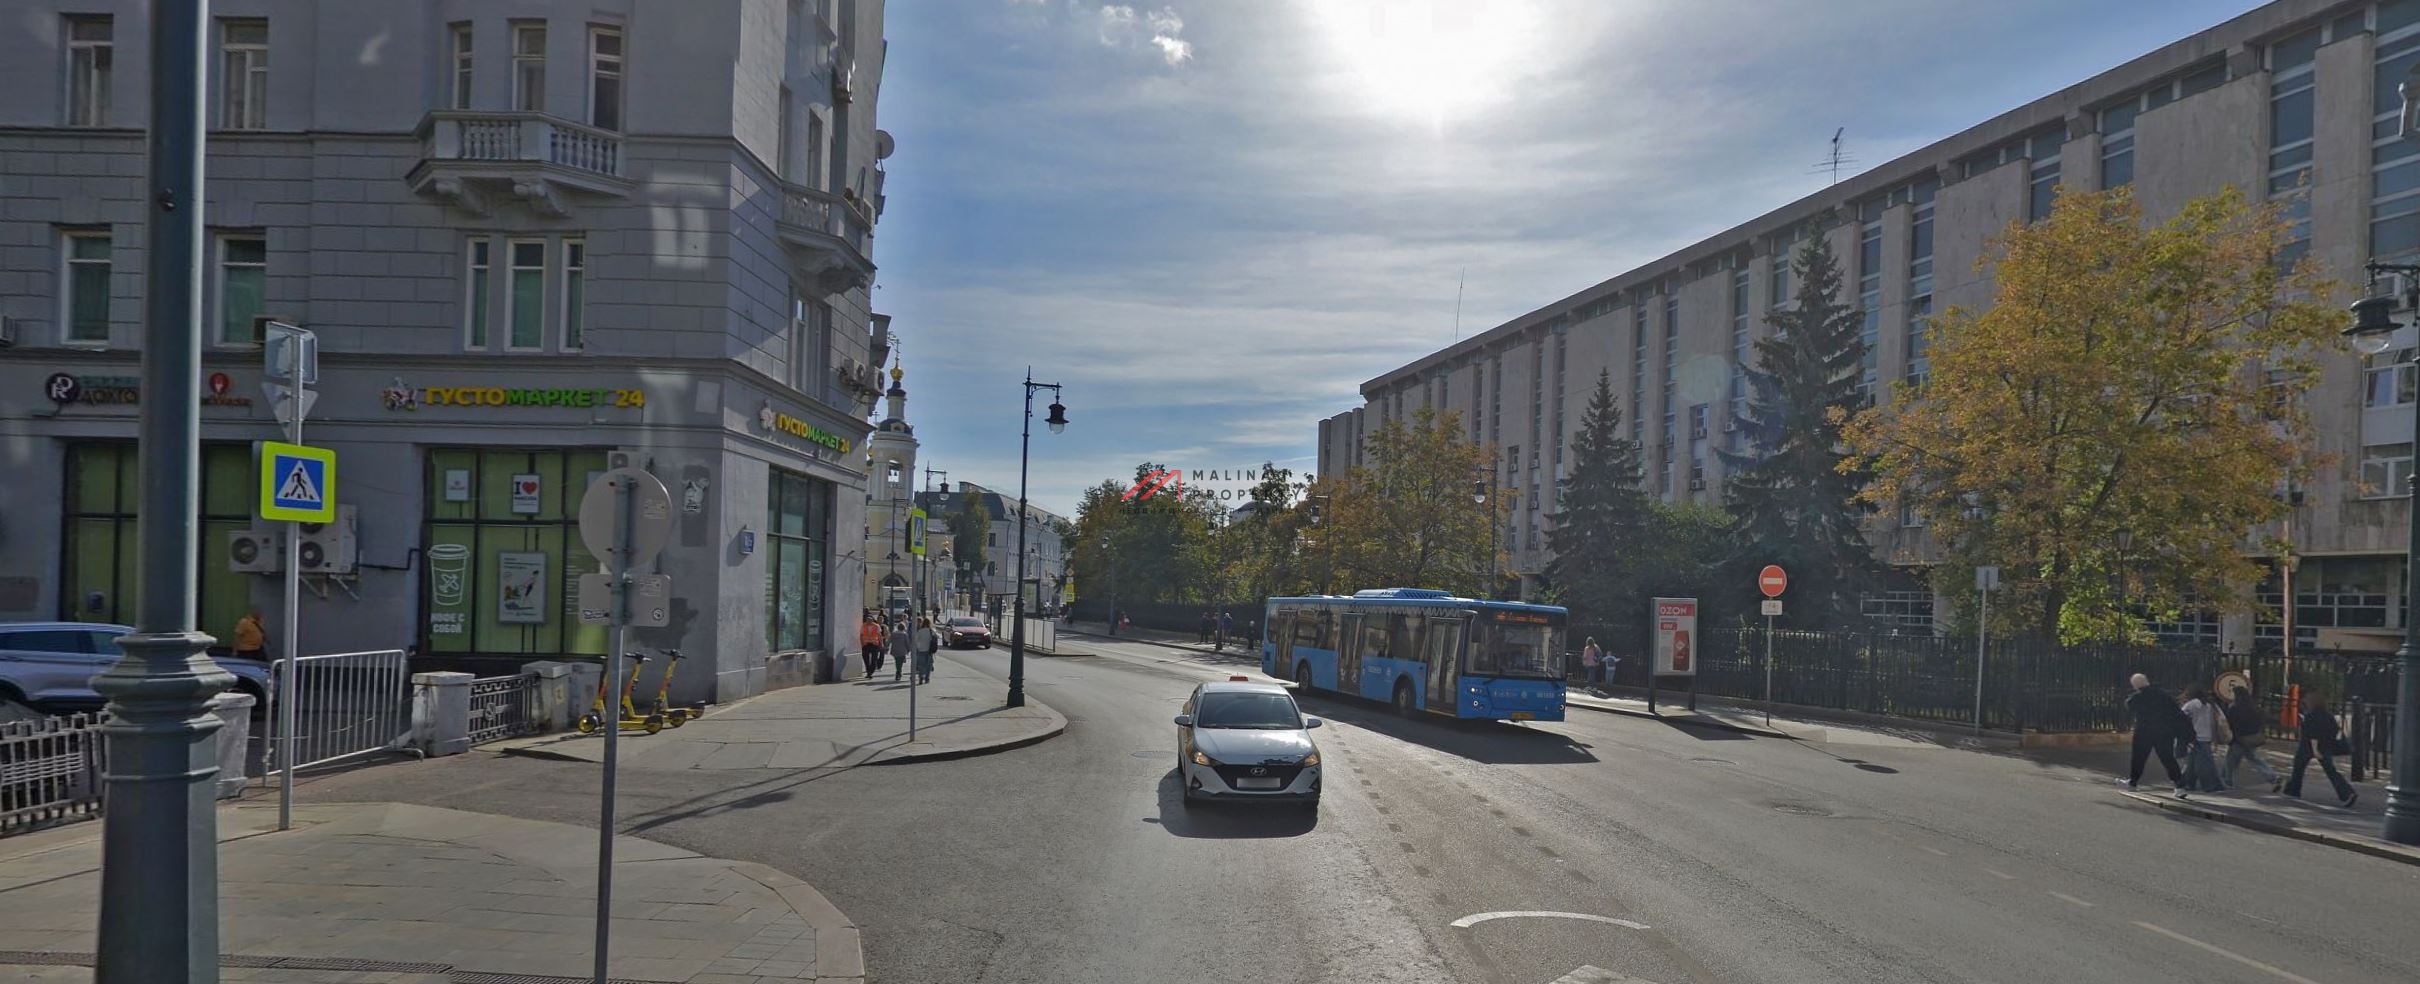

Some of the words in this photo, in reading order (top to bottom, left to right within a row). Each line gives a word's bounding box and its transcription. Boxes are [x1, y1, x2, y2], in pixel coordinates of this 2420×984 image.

[425, 387, 608, 408] ГУСТОМАРКЕТ
[614, 388, 645, 408] 24
[778, 413, 840, 449] ГУСТОМАРКЕТ
[840, 438, 850, 453] 24
[1660, 606, 1688, 616] OZON
